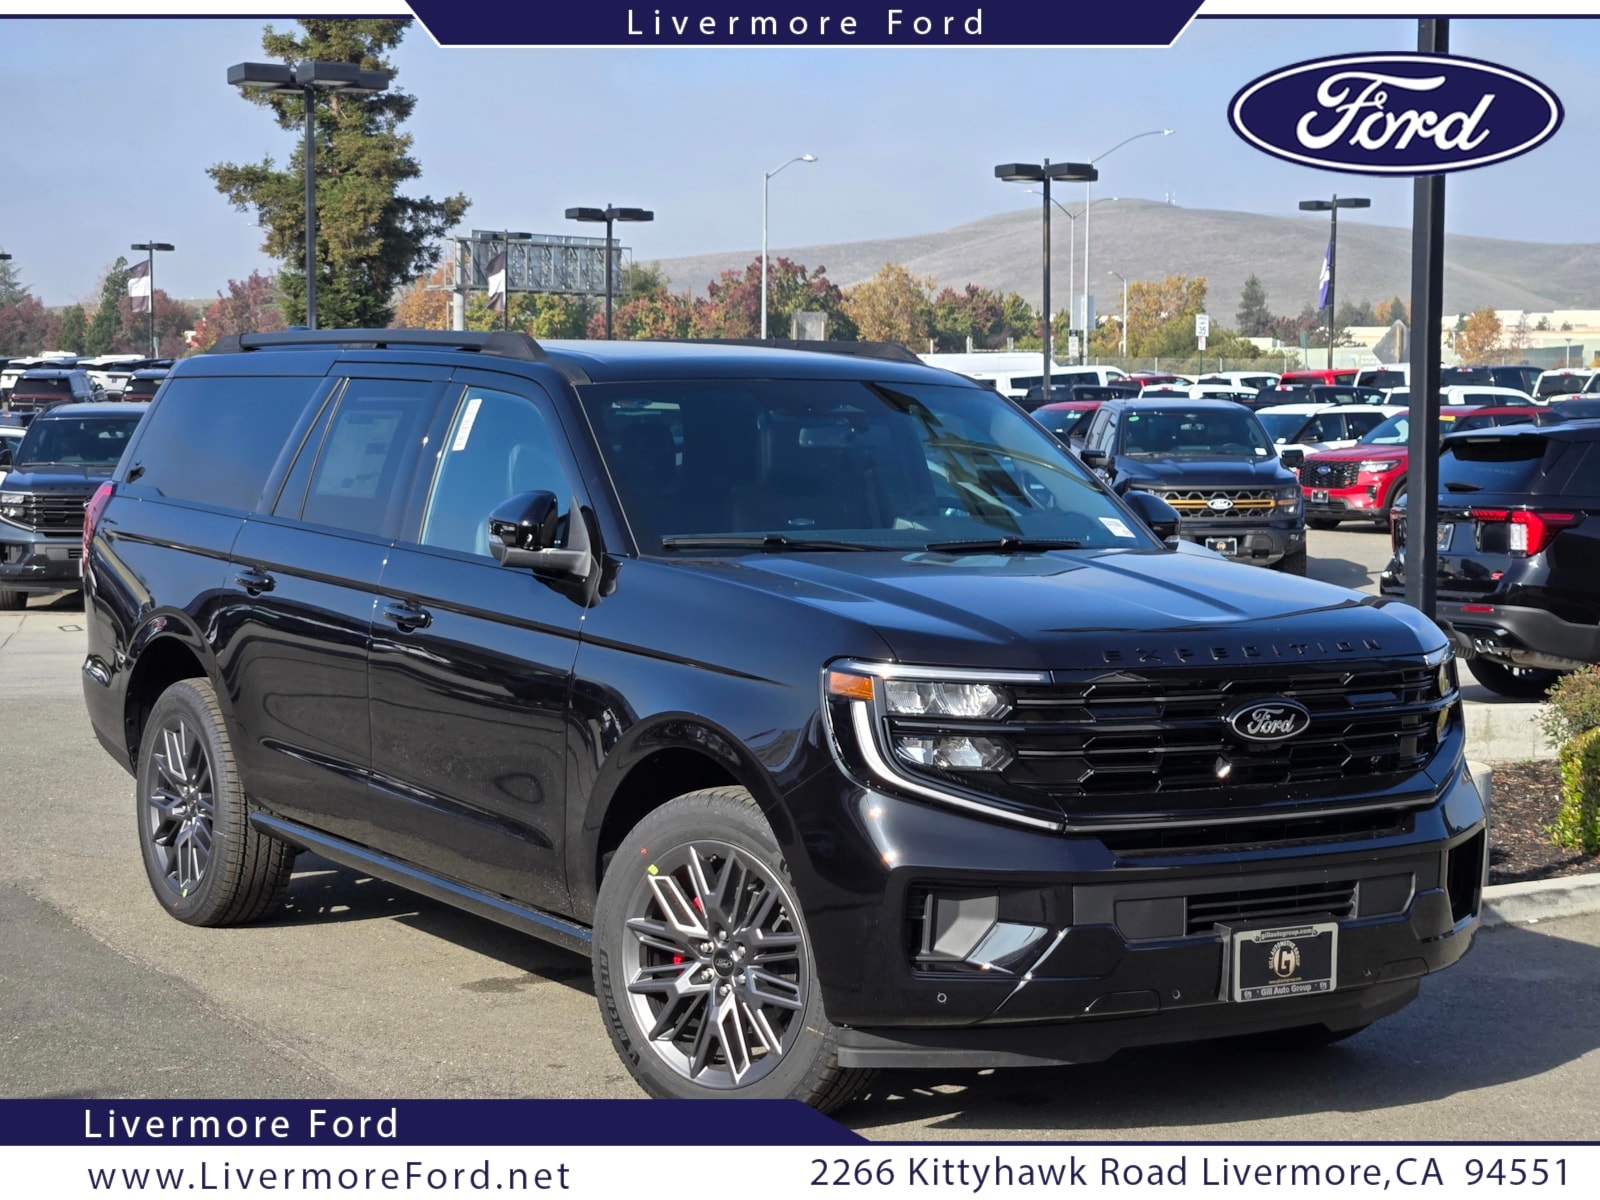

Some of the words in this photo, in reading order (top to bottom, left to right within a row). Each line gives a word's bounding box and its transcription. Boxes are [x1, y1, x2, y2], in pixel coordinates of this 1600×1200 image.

[1103, 639, 1381, 663] EXPEDITION
[1247, 707, 1296, 734] Ford
[600, 948, 632, 1043] MICHELIN
[1260, 986, 1273, 996] Gill
[1273, 986, 1290, 995] Auto
[1291, 983, 1312, 994] Group
